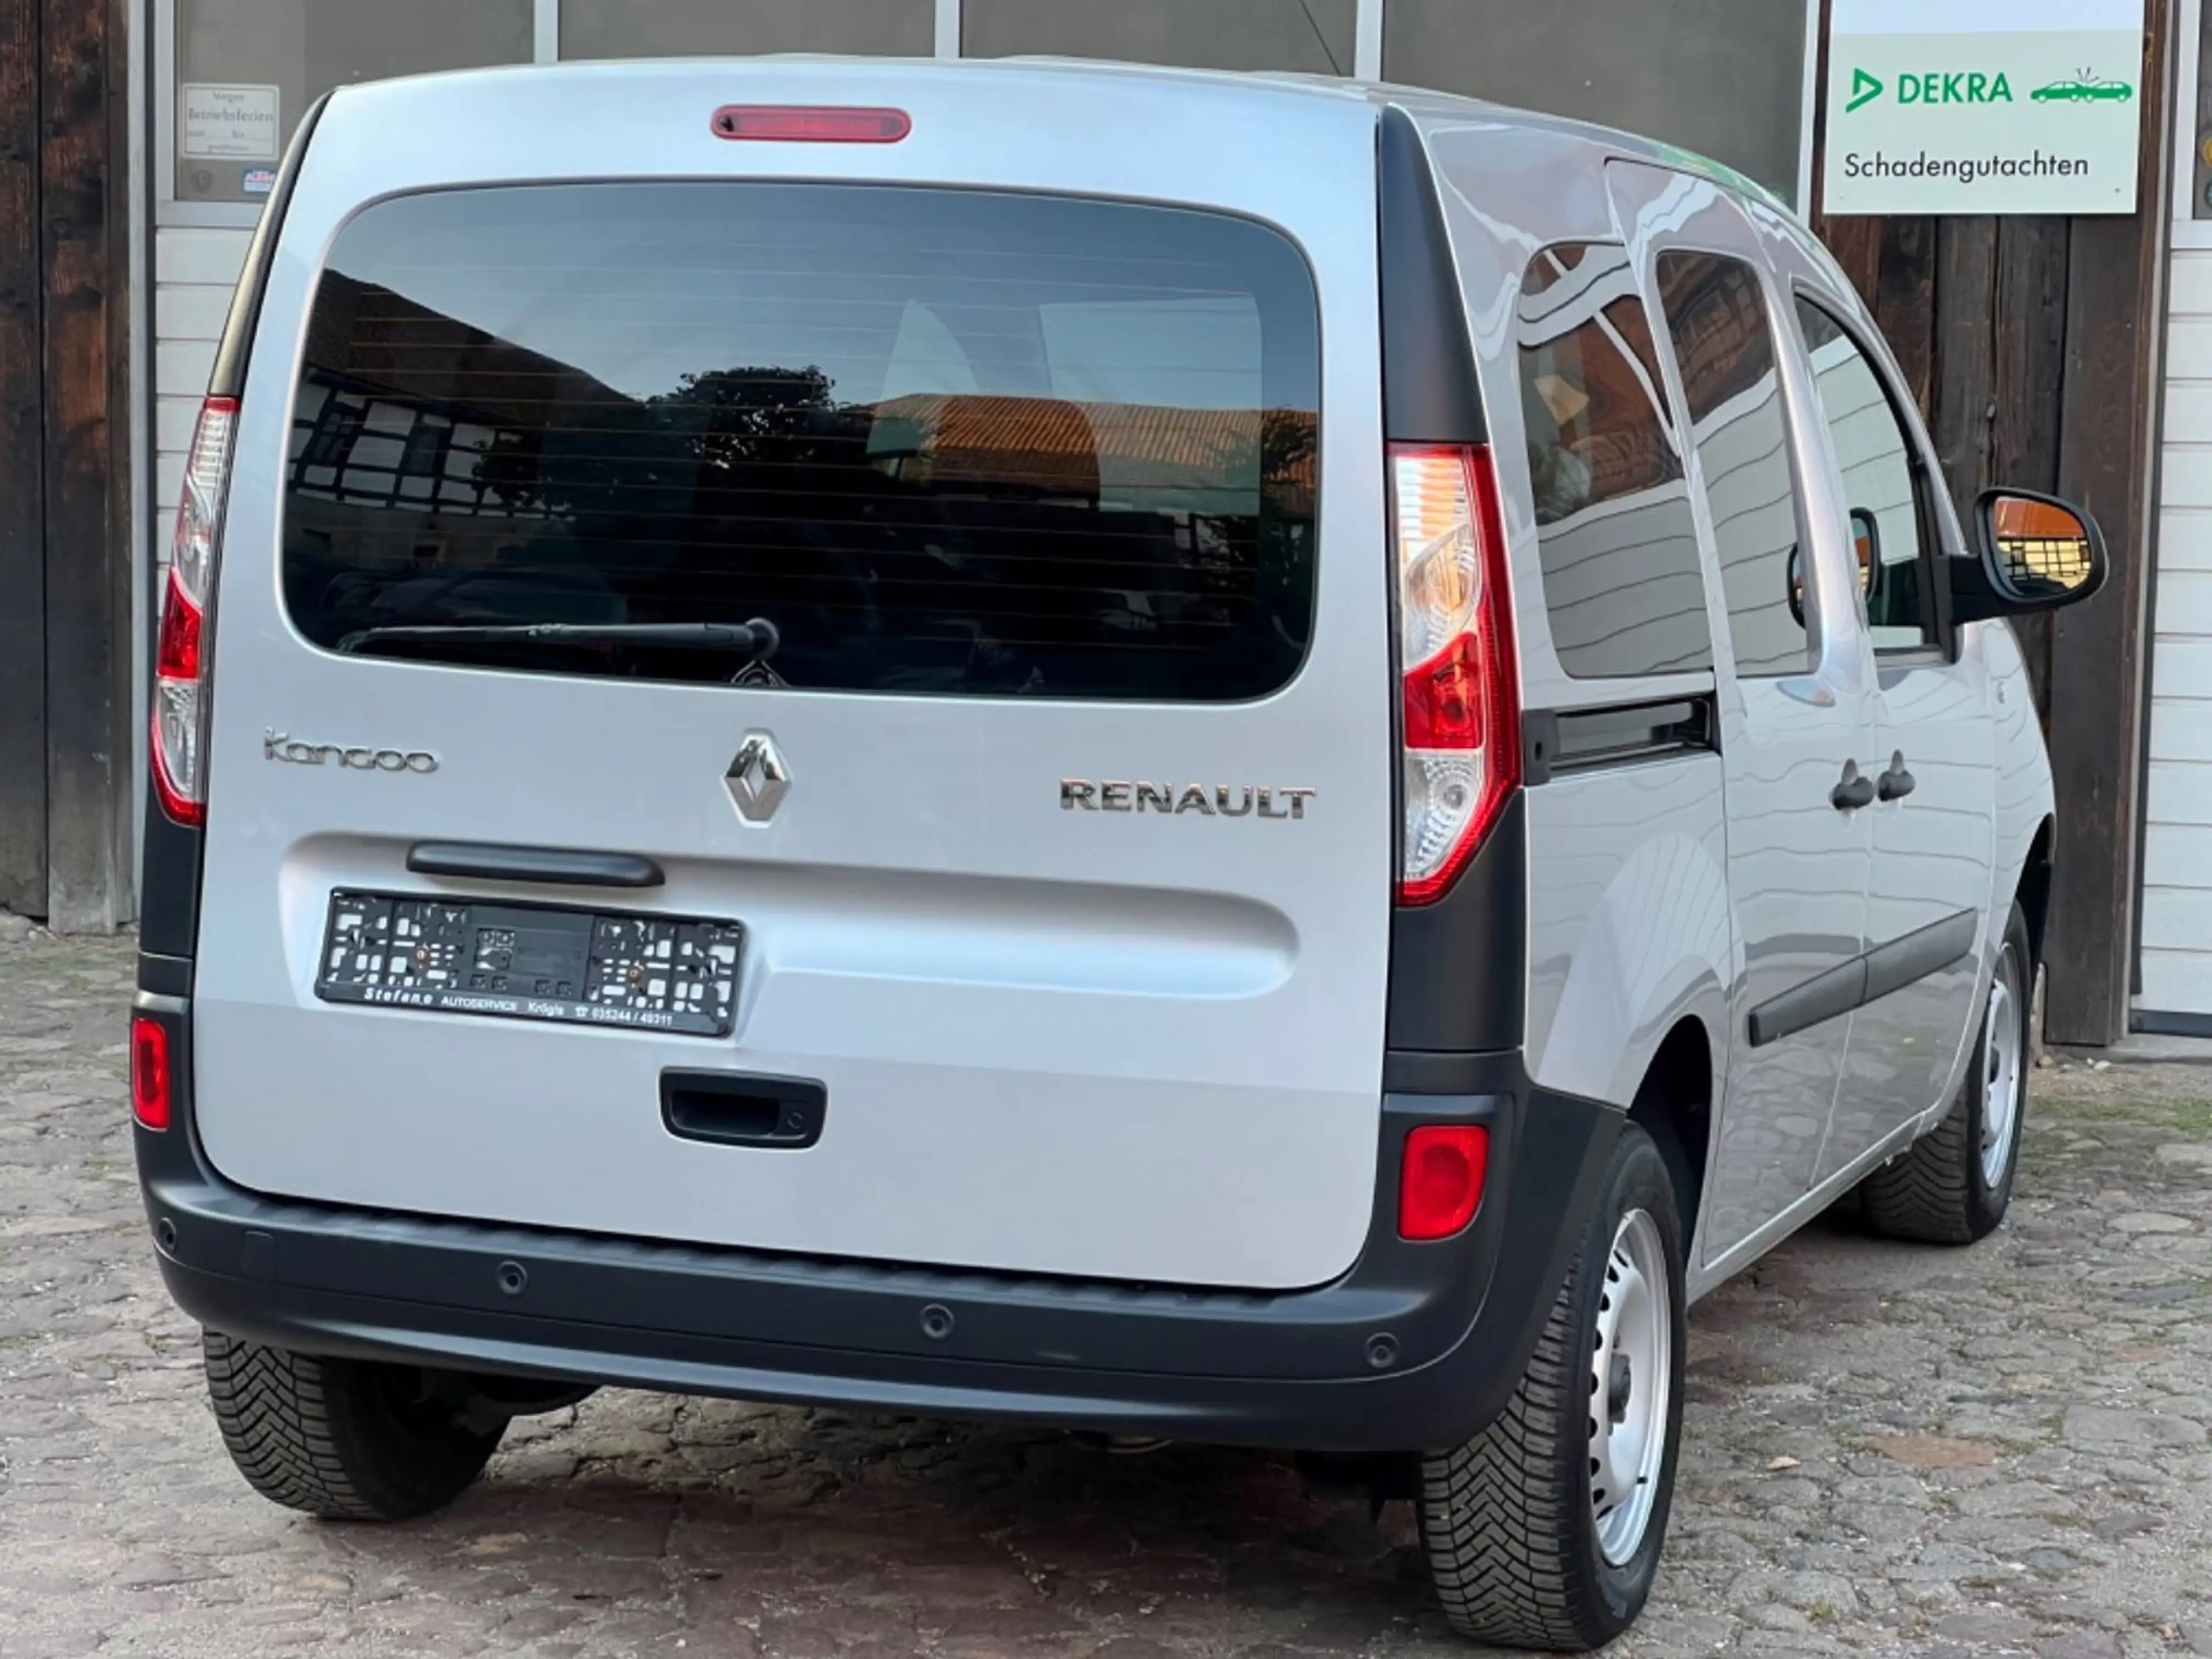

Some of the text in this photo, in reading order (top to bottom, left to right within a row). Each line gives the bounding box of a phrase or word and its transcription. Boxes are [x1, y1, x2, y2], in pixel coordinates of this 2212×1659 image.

[1898, 72, 2014, 104] DEKRA
[1844, 150, 2089, 183] Schadengutachten
[264, 726, 441, 774] Kangoo
[1060, 778, 1317, 819] RENAULT
